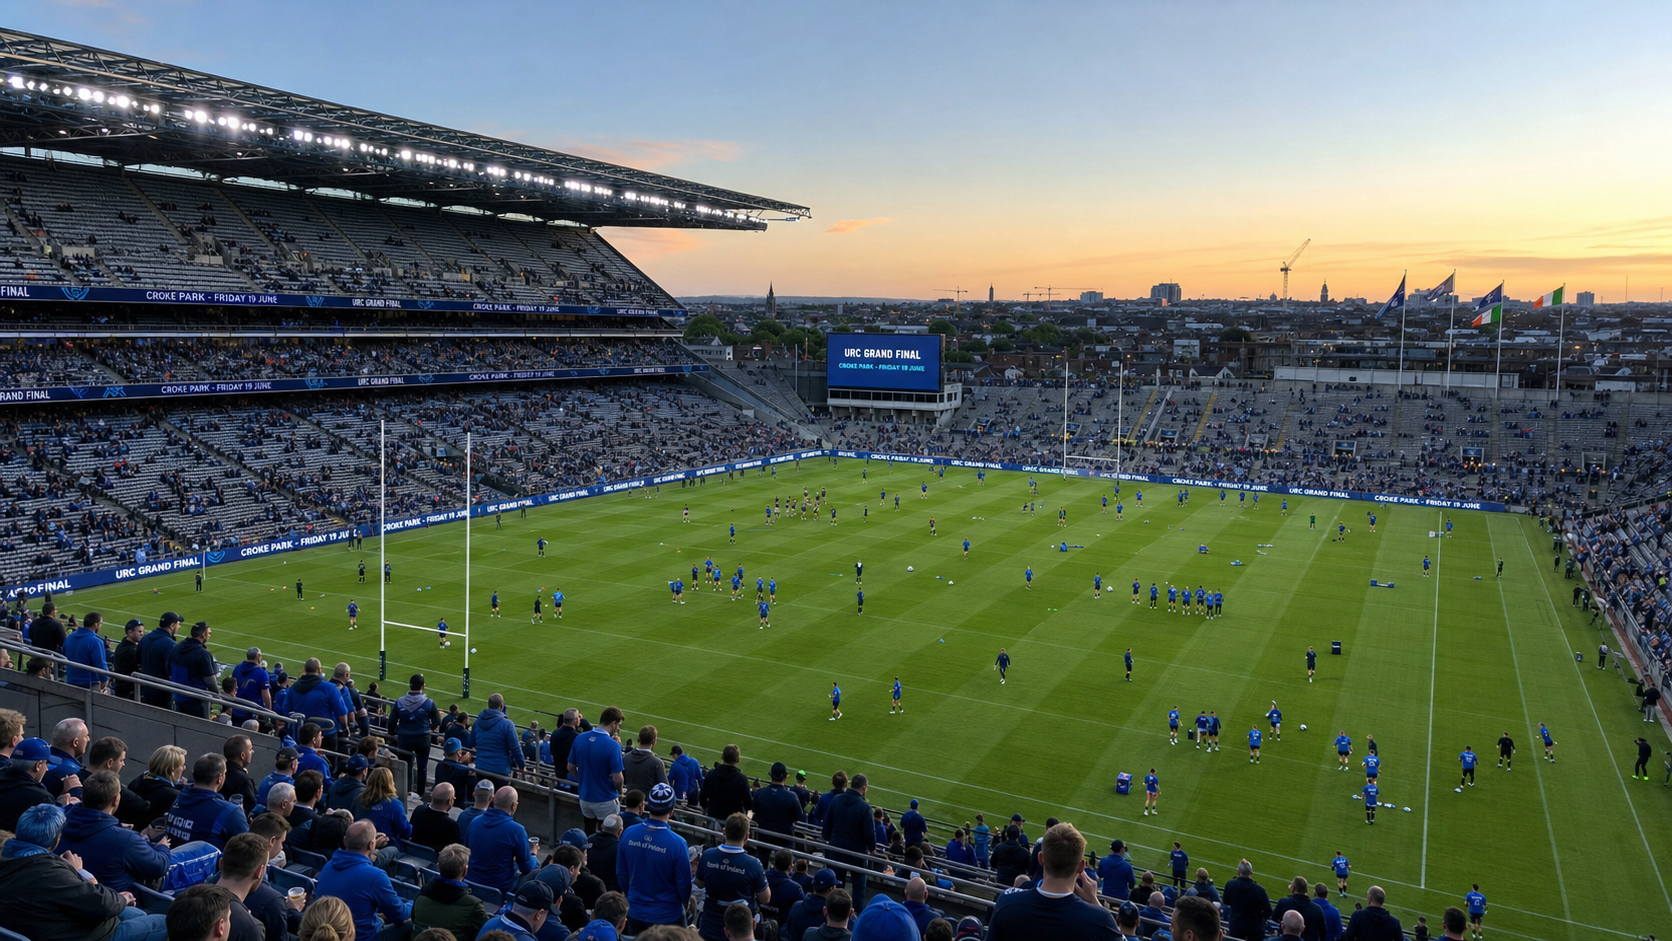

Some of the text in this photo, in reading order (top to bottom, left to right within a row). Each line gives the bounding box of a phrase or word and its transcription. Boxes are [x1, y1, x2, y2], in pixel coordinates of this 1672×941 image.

[0, 286, 30, 297] FINAL
[146, 291, 176, 300] CROKE
[180, 292, 205, 301] PARK
[214, 294, 246, 303] FRIDAY
[258, 296, 278, 304] JUNE
[844, 348, 921, 360] URC GRAND FINAL
[161, 385, 187, 394] CROKE
[189, 384, 210, 393] PARK
[216, 383, 243, 391] FRIDAY
[245, 382, 252, 390] 19
[26, 390, 50, 400] FINAL
[241, 543, 270, 556] CROKE
[270, 540, 293, 552] PARK
[300, 534, 327, 546] FRIDAY
[329, 532, 337, 540] 19
[115, 556, 200, 579] URC GRAND FINAL
[37, 579, 71, 593] FINAL
